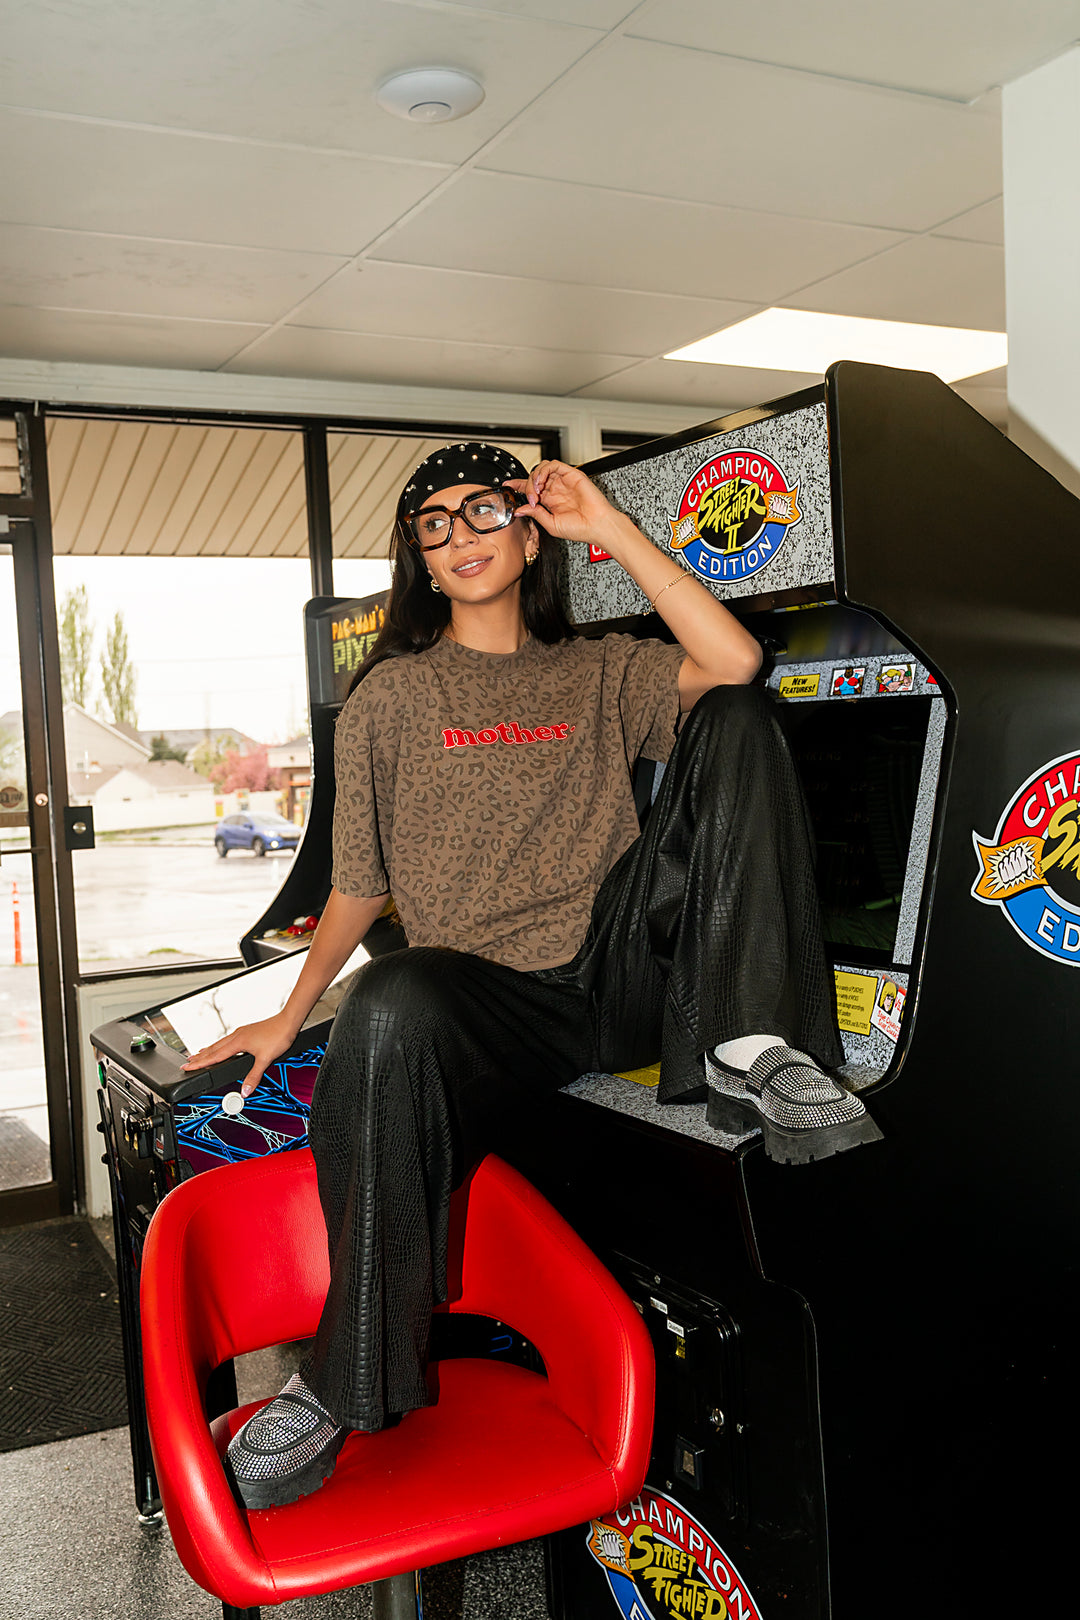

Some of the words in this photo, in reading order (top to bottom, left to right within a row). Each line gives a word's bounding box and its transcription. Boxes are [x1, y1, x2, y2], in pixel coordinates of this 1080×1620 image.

[687, 457, 774, 508] CHAMPION
[698, 476, 741, 531] STREET
[707, 483, 767, 534] FIGHTER
[698, 535, 773, 575] EDITION
[723, 522, 744, 555] II
[628, 1524, 697, 1578] STREET
